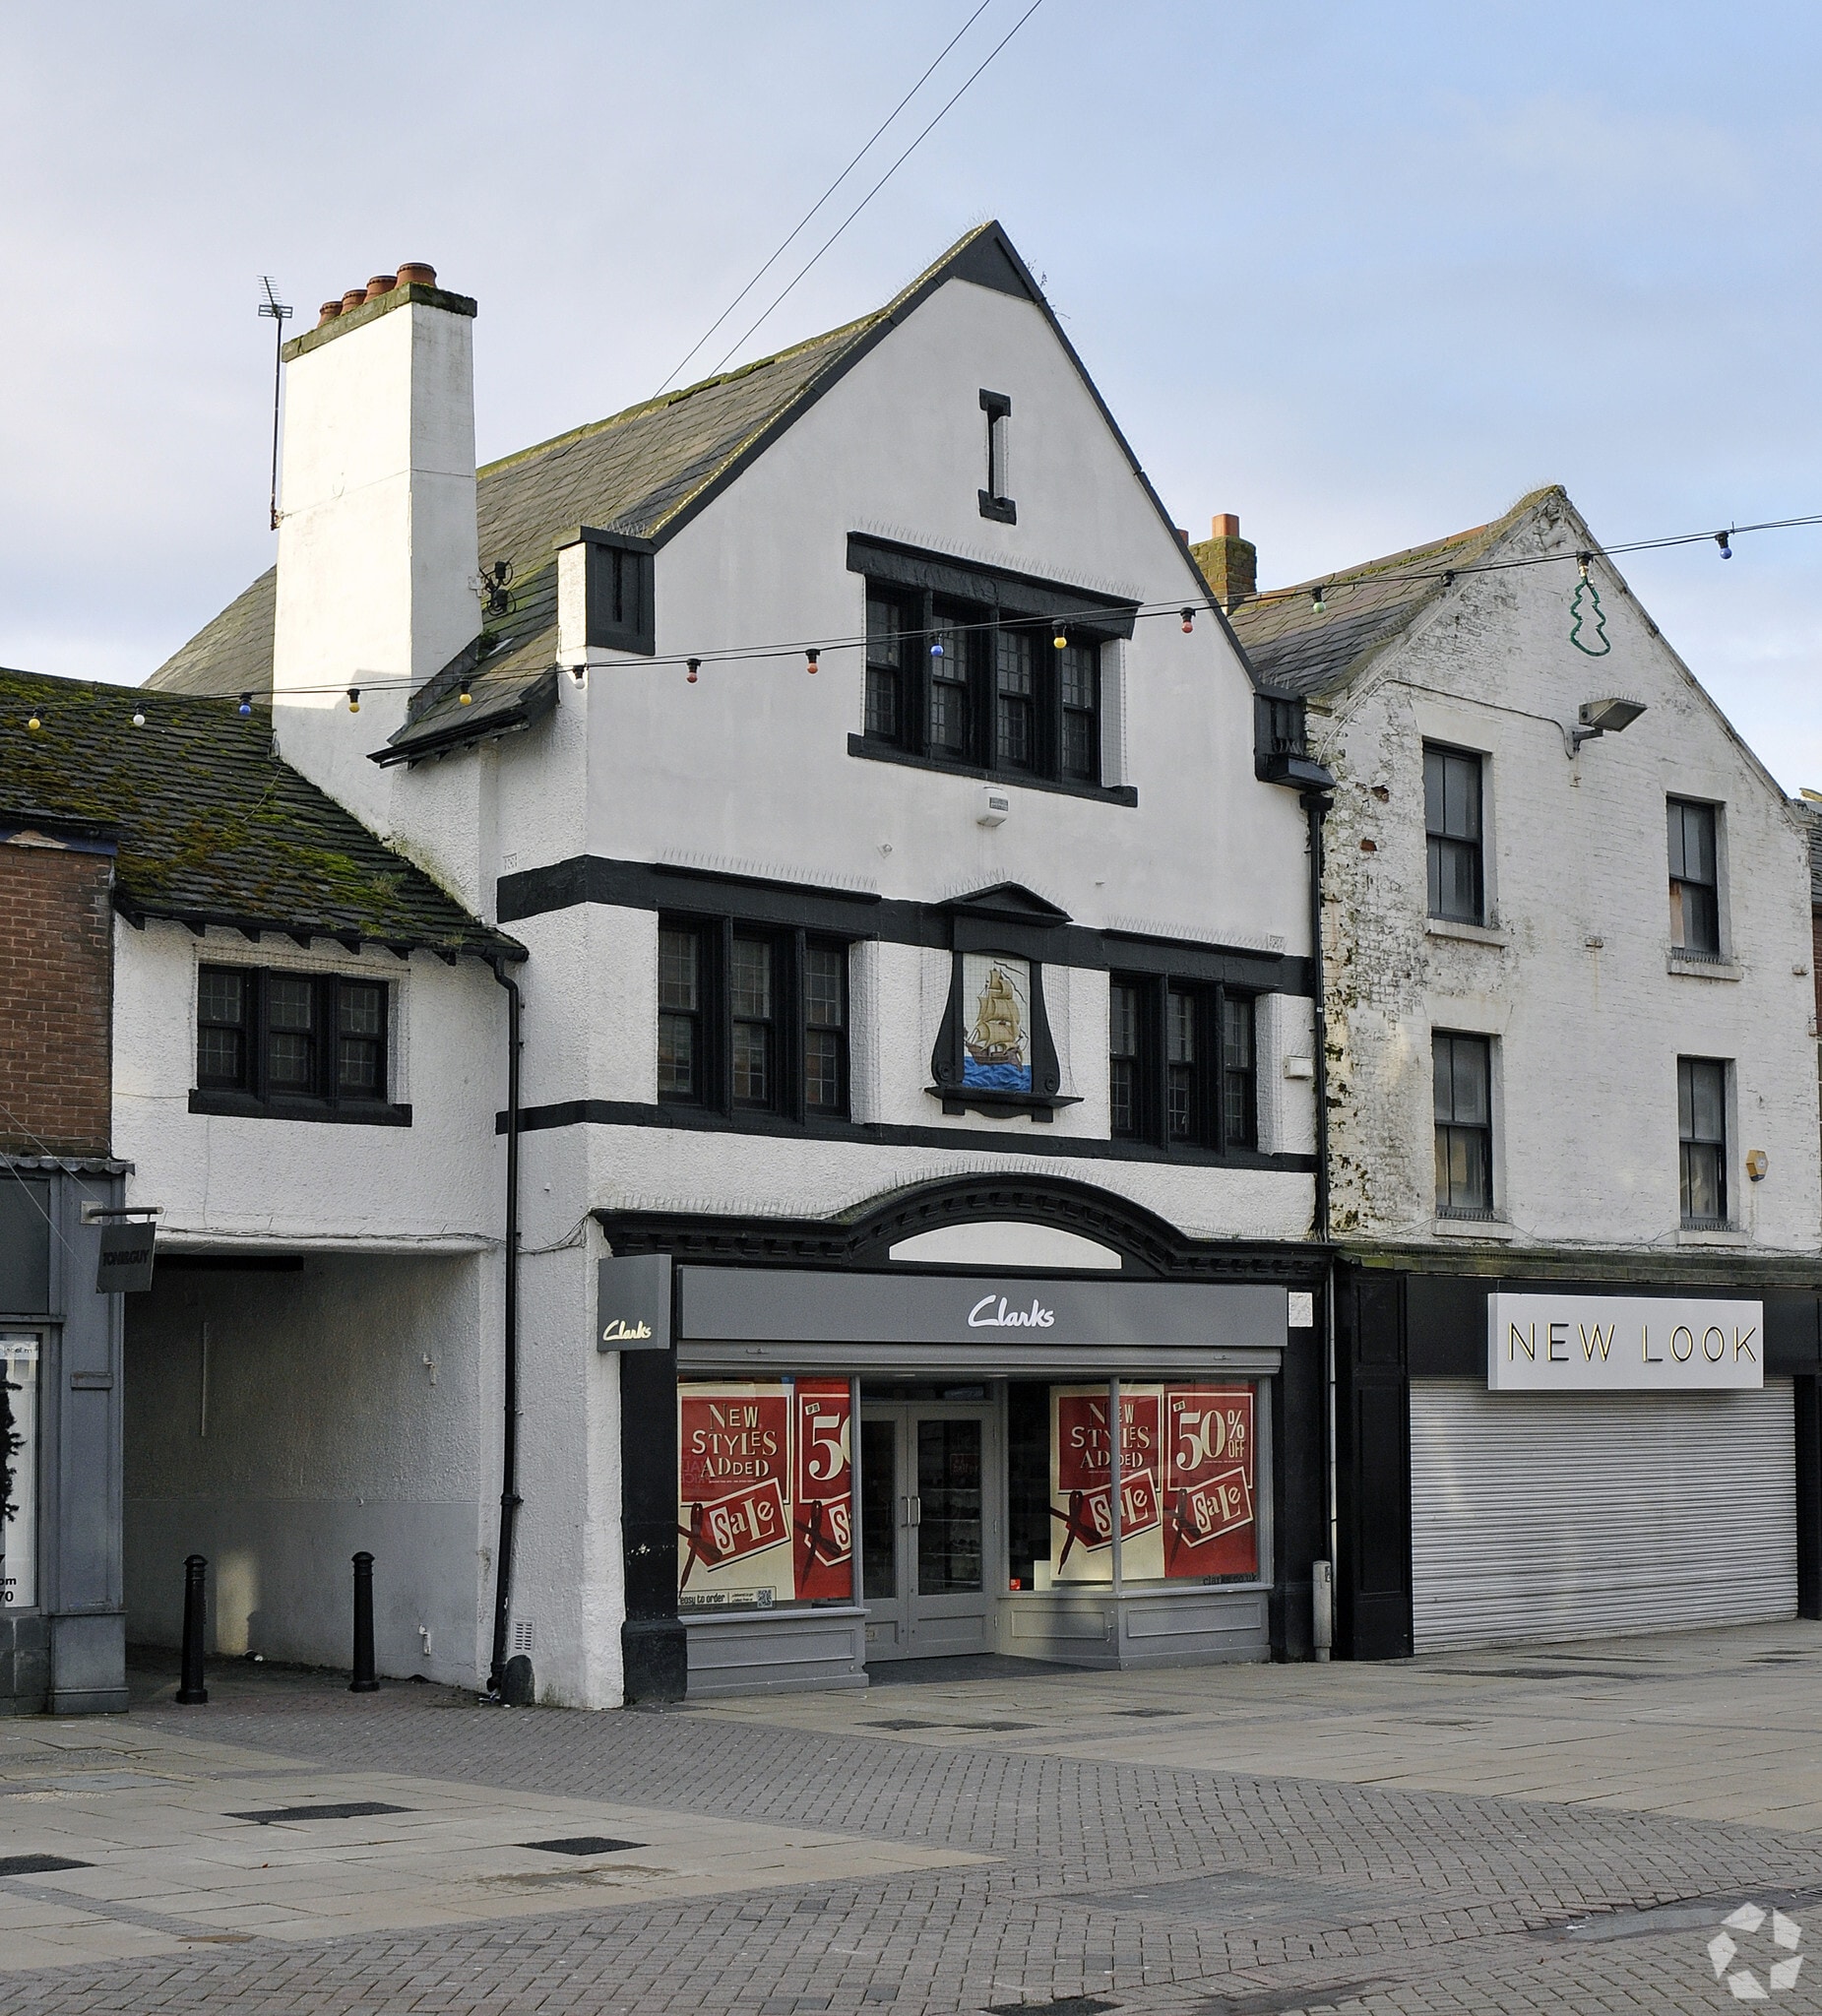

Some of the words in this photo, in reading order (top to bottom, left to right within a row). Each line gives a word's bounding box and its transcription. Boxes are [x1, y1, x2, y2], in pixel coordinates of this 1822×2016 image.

[968, 1294, 1055, 1328] Clarks
[602, 1319, 652, 1341] Clarks
[1508, 1322, 1615, 1362] NEW
[1642, 1324, 1757, 1362] LOOK
[707, 1404, 759, 1430] NEW
[691, 1429, 778, 1456] STYLES
[1227, 1440, 1245, 1458] OFF
[700, 1456, 770, 1478] ADDED
[697, 1594, 706, 1604] to
[706, 1593, 725, 1604] order
